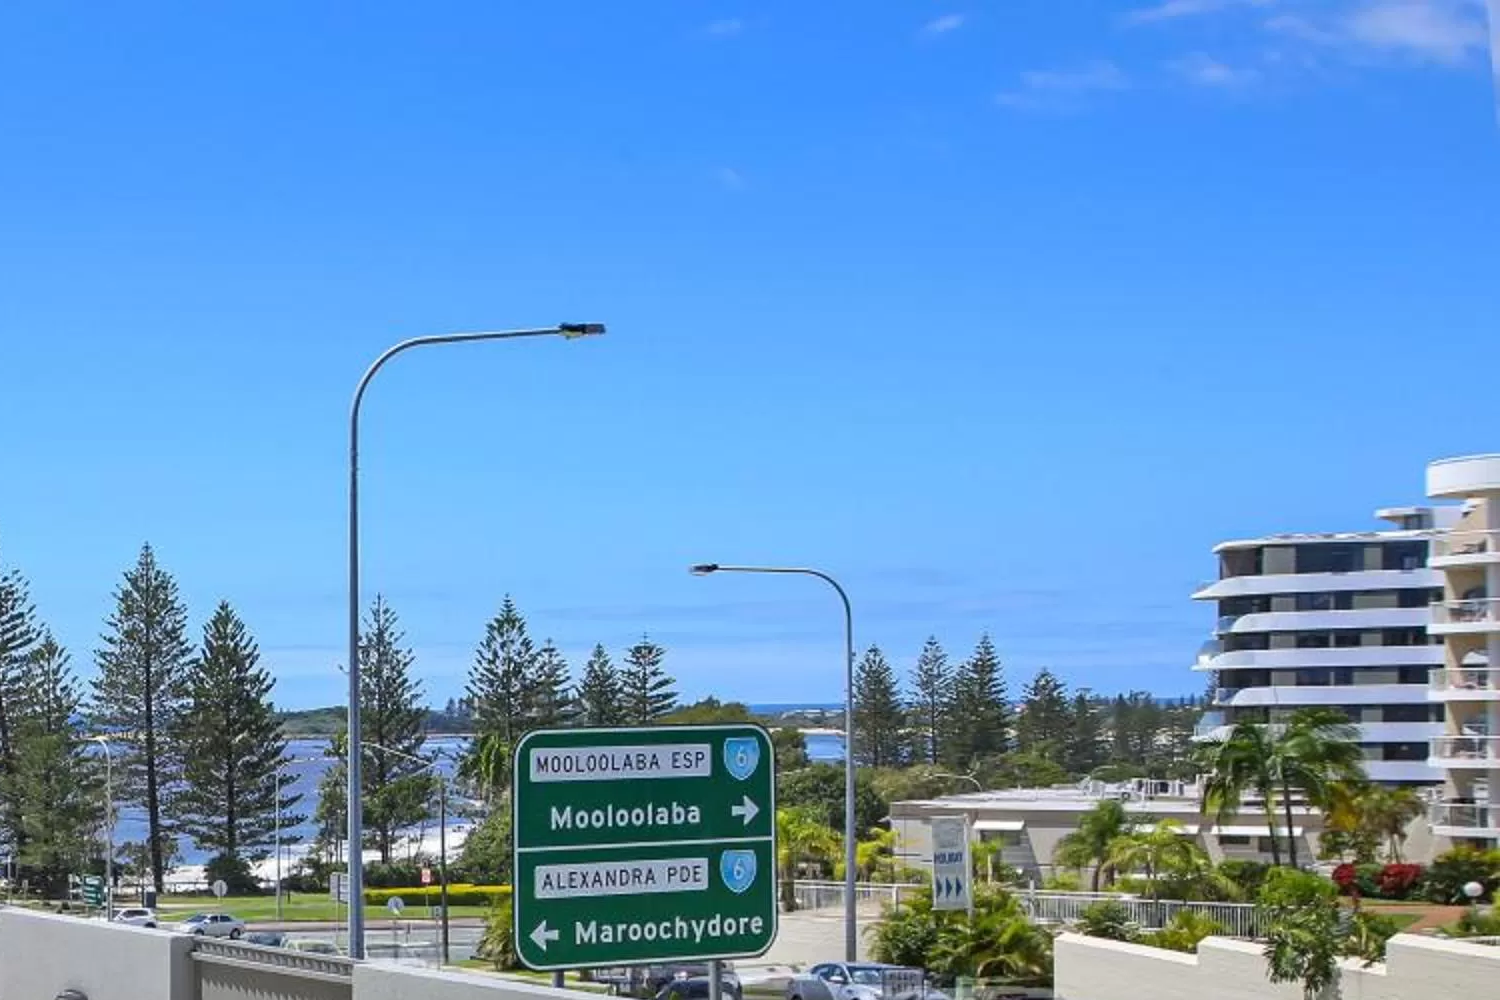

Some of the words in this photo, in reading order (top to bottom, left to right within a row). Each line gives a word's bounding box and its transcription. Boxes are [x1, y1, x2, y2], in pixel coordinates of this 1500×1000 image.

[536, 752, 661, 773] MOOLOOLABA
[671, 751, 705, 769] ESP
[736, 748, 746, 767] 6
[550, 802, 701, 830] Mooloolaba
[542, 868, 656, 891] ALEXANDRA
[667, 865, 702, 883] PDE
[733, 859, 743, 880] 6
[574, 913, 763, 944] Maroochydore
